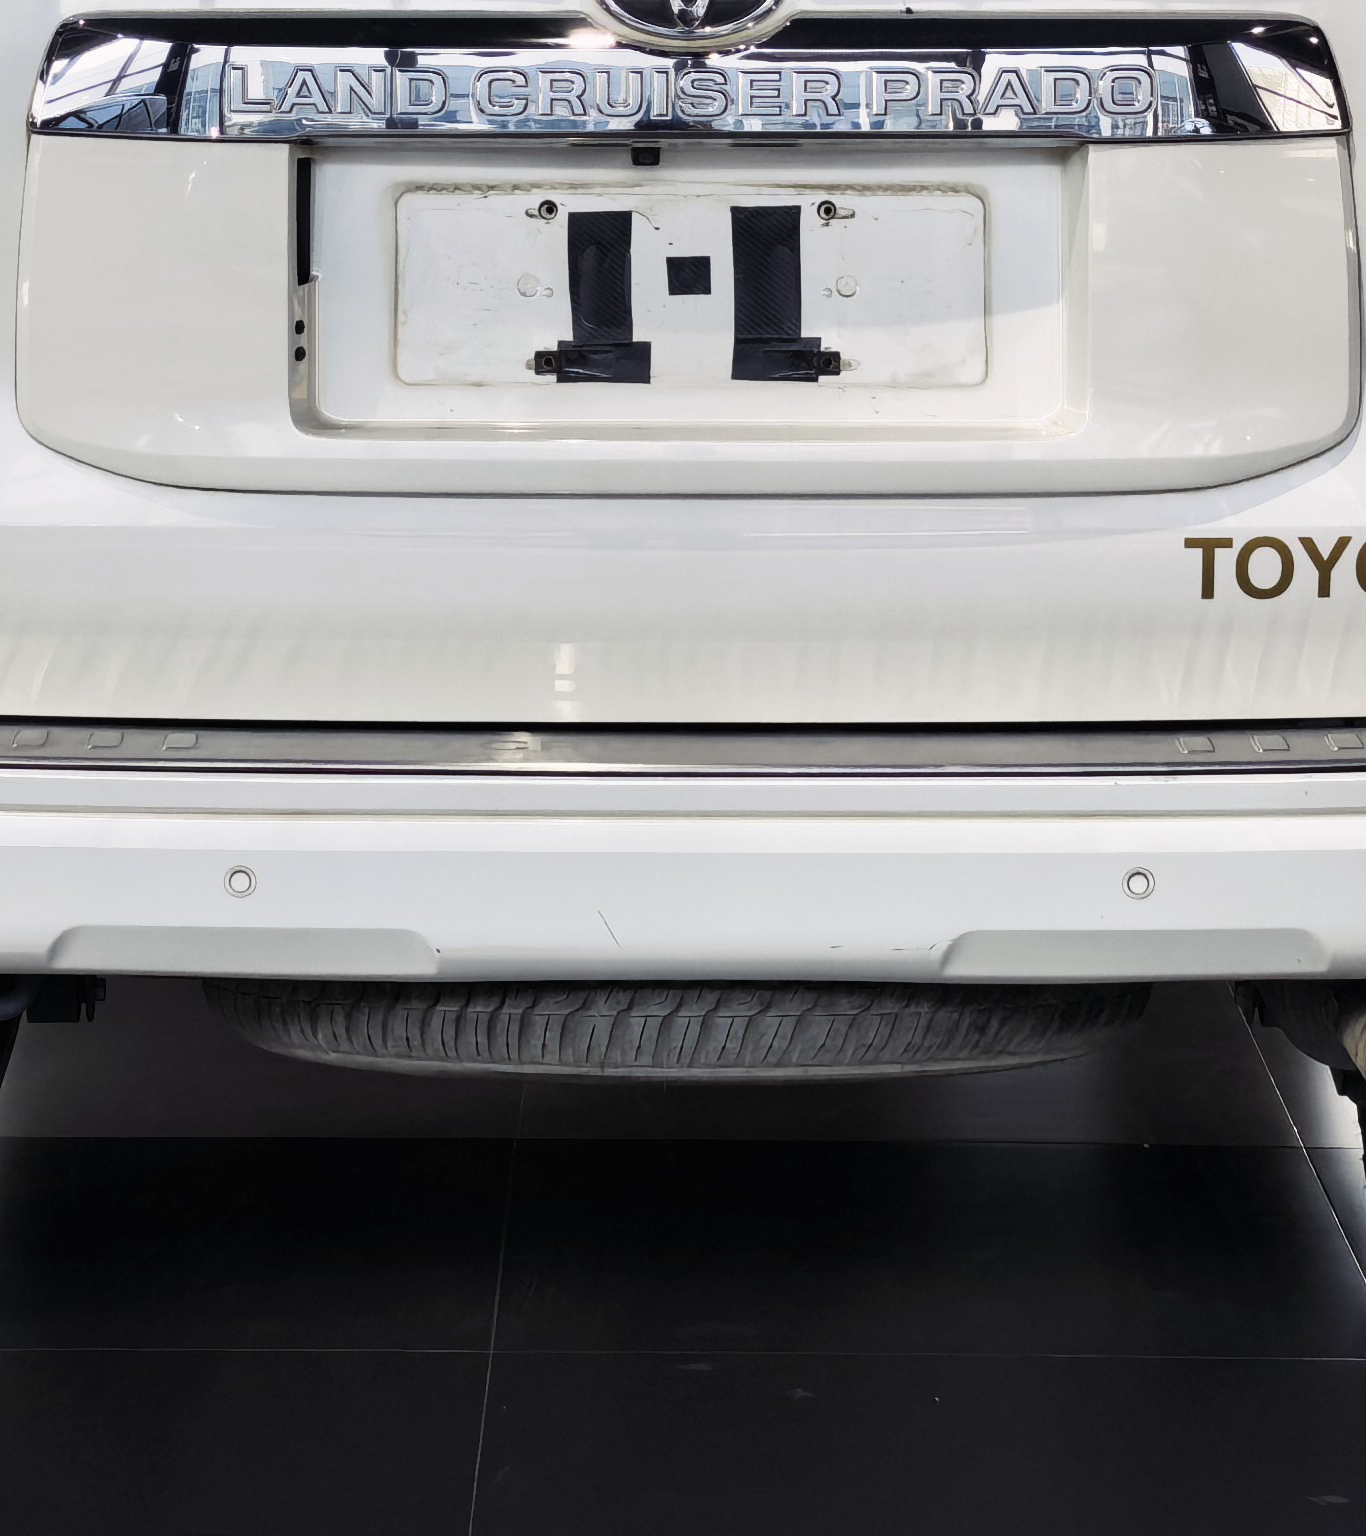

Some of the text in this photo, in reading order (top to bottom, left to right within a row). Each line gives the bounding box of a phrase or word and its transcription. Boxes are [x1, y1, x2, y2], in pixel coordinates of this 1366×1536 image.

[229, 64, 1157, 119] LAND CRUISER PRADO
